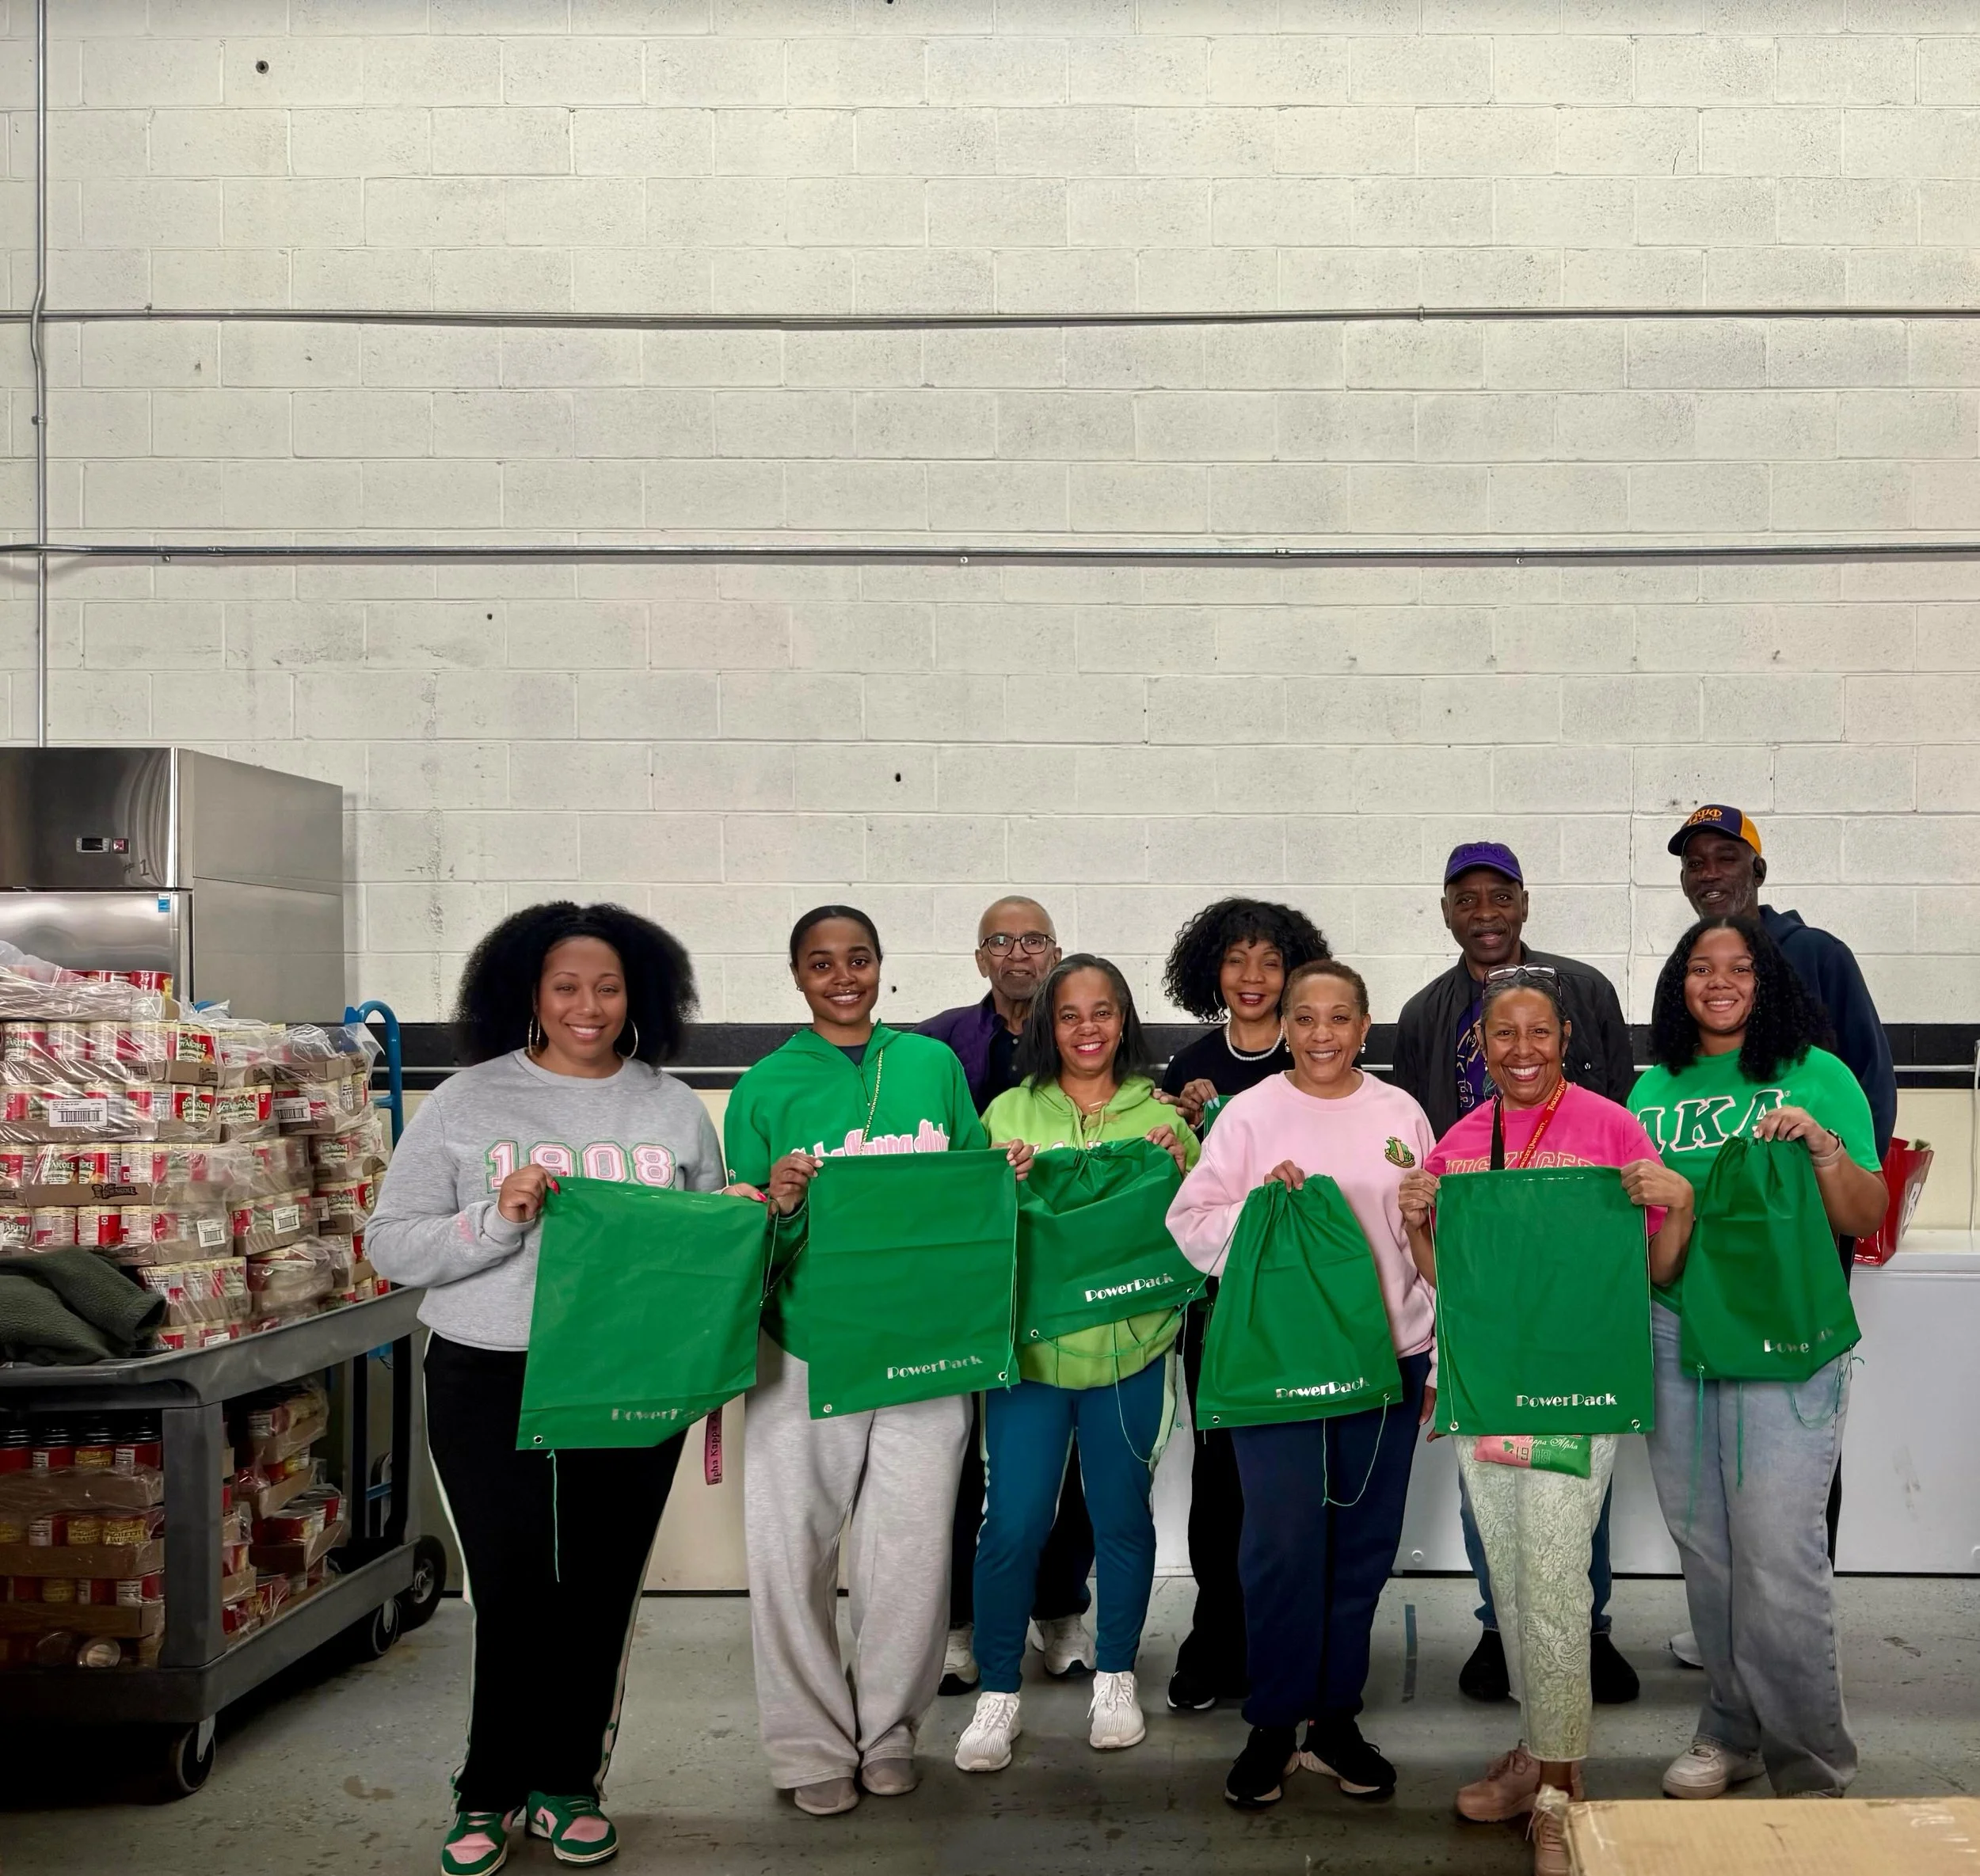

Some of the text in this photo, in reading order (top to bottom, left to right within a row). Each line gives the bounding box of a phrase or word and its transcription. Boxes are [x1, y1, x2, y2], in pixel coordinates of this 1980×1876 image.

[484, 1139, 677, 1193] 1908
[1085, 1273, 1174, 1303] PowerPack
[887, 1355, 983, 1379] PowerPack
[1275, 1376, 1370, 1398] PowerPack
[1516, 1393, 1617, 1407] PowerPack
